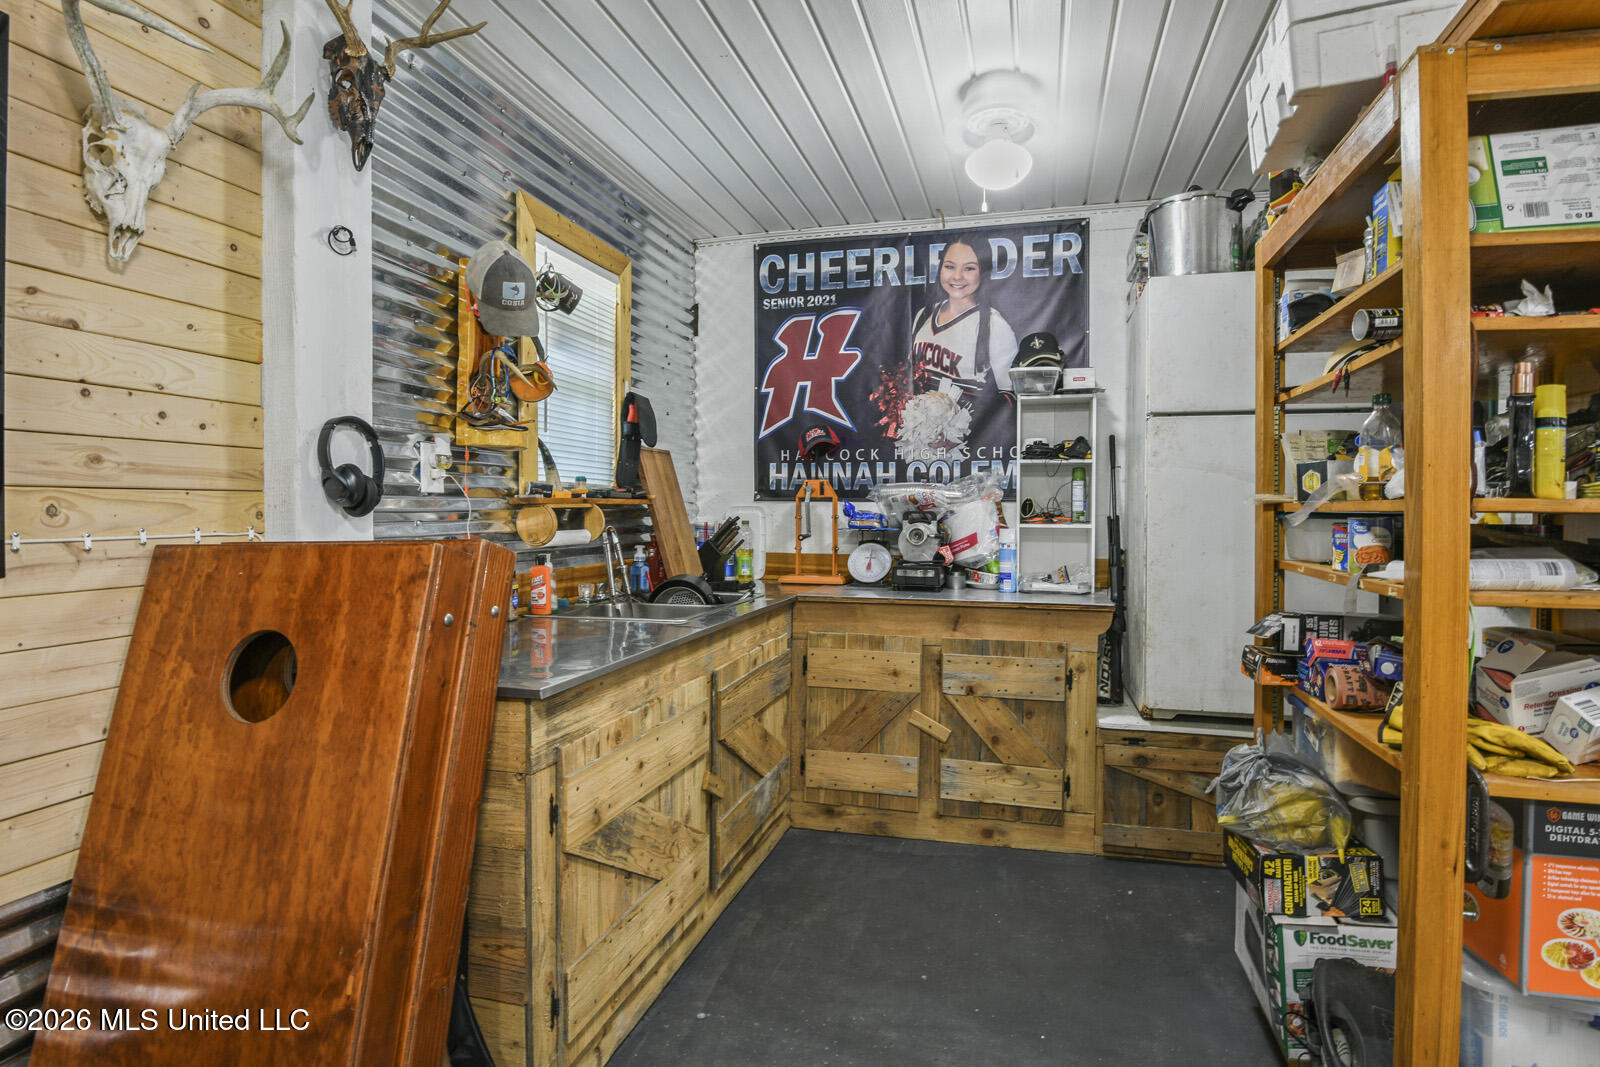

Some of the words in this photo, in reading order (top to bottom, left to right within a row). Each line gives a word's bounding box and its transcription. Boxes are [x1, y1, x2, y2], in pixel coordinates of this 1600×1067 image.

[763, 296, 804, 310] SENIOR
[807, 294, 837, 307] 2021
[894, 447, 946, 460] HIGH
[1562, 811, 1585, 821] GAME
[1545, 825, 1586, 836] DIGITAL
[1550, 834, 1600, 845] DEHYDRA
[1264, 860, 1275, 876] 42
[1283, 858, 1294, 915] CONTRACTOR
[1362, 900, 1371, 914] 24
[1309, 932, 1394, 950] FoodSaver
